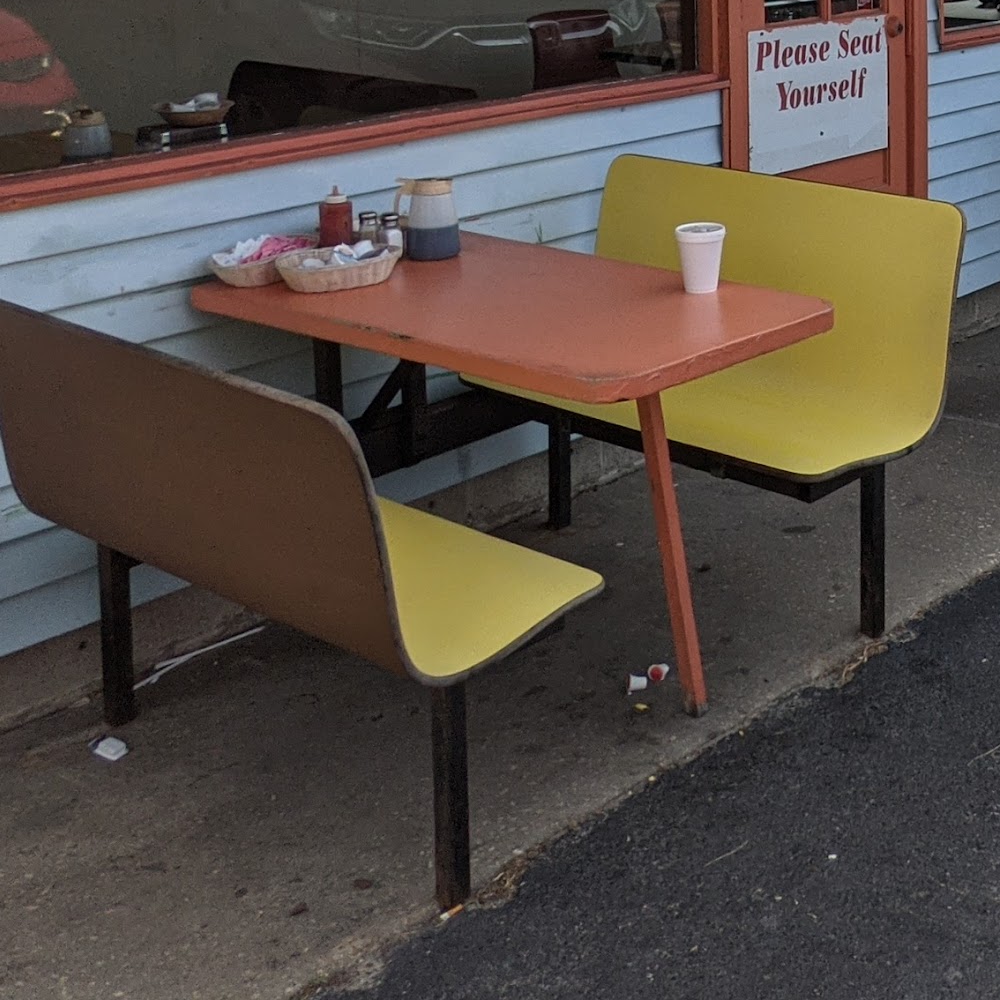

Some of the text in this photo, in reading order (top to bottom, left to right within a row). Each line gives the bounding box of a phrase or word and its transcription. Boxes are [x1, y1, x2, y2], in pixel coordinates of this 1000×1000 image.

[755, 28, 882, 73] Please Seat
[776, 67, 867, 112] Yourself
